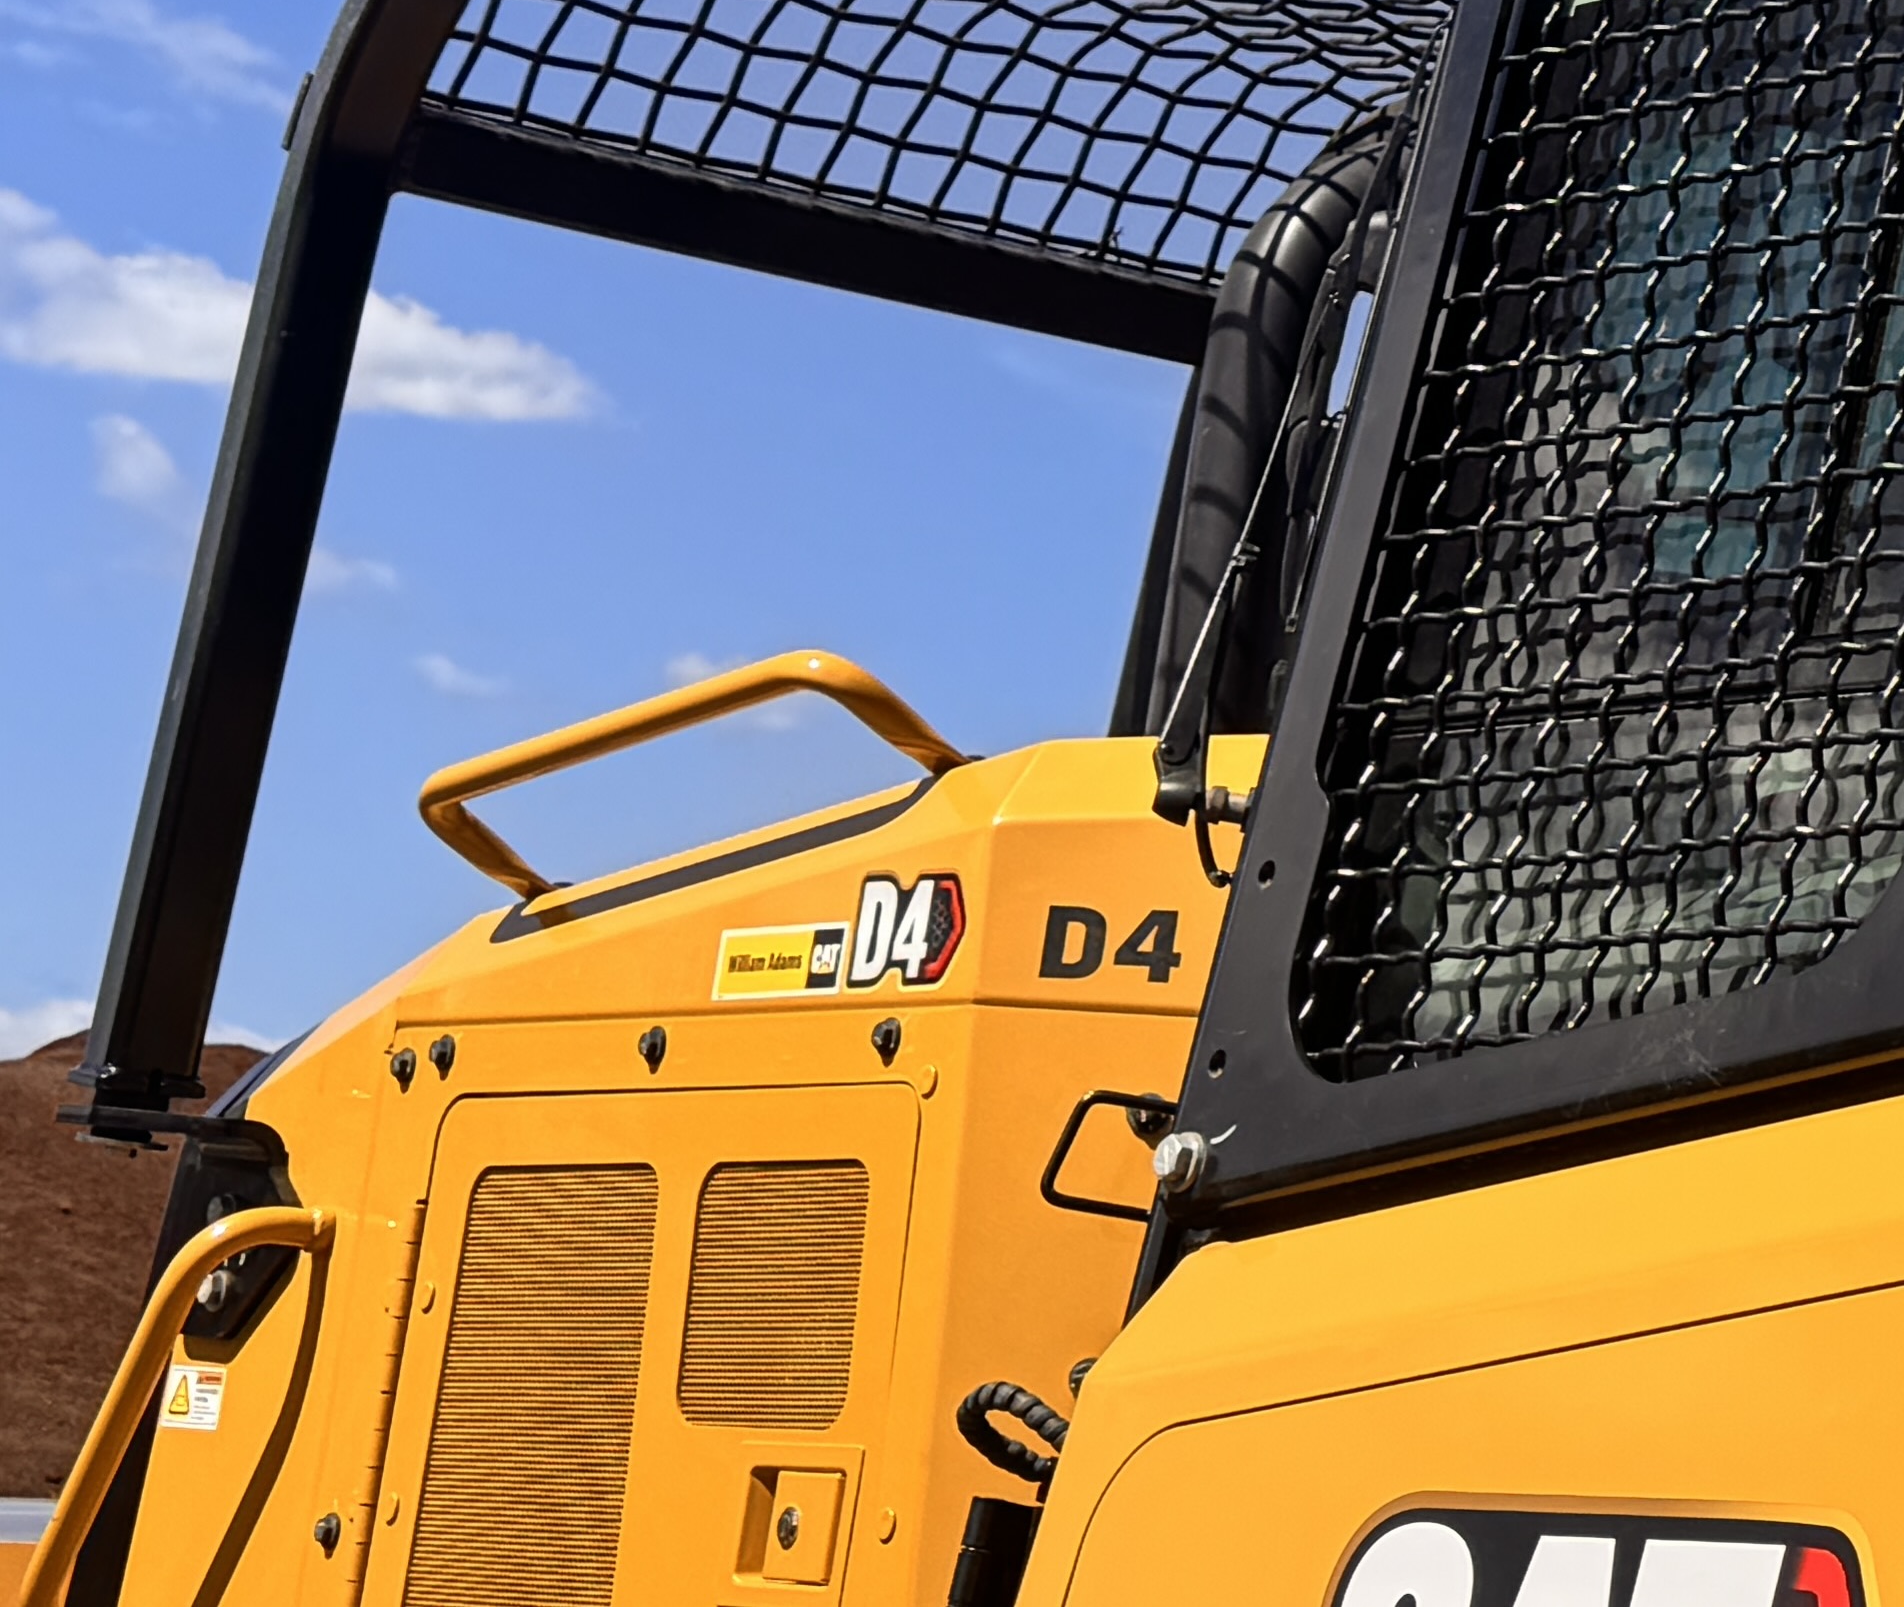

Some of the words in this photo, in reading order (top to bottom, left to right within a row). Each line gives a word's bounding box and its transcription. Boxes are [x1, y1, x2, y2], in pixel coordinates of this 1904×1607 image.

[850, 880, 935, 981] D4
[1039, 905, 1182, 983] D4
[728, 954, 765, 973] William
[767, 952, 802, 971] Adams
[811, 943, 841, 974] CAT
